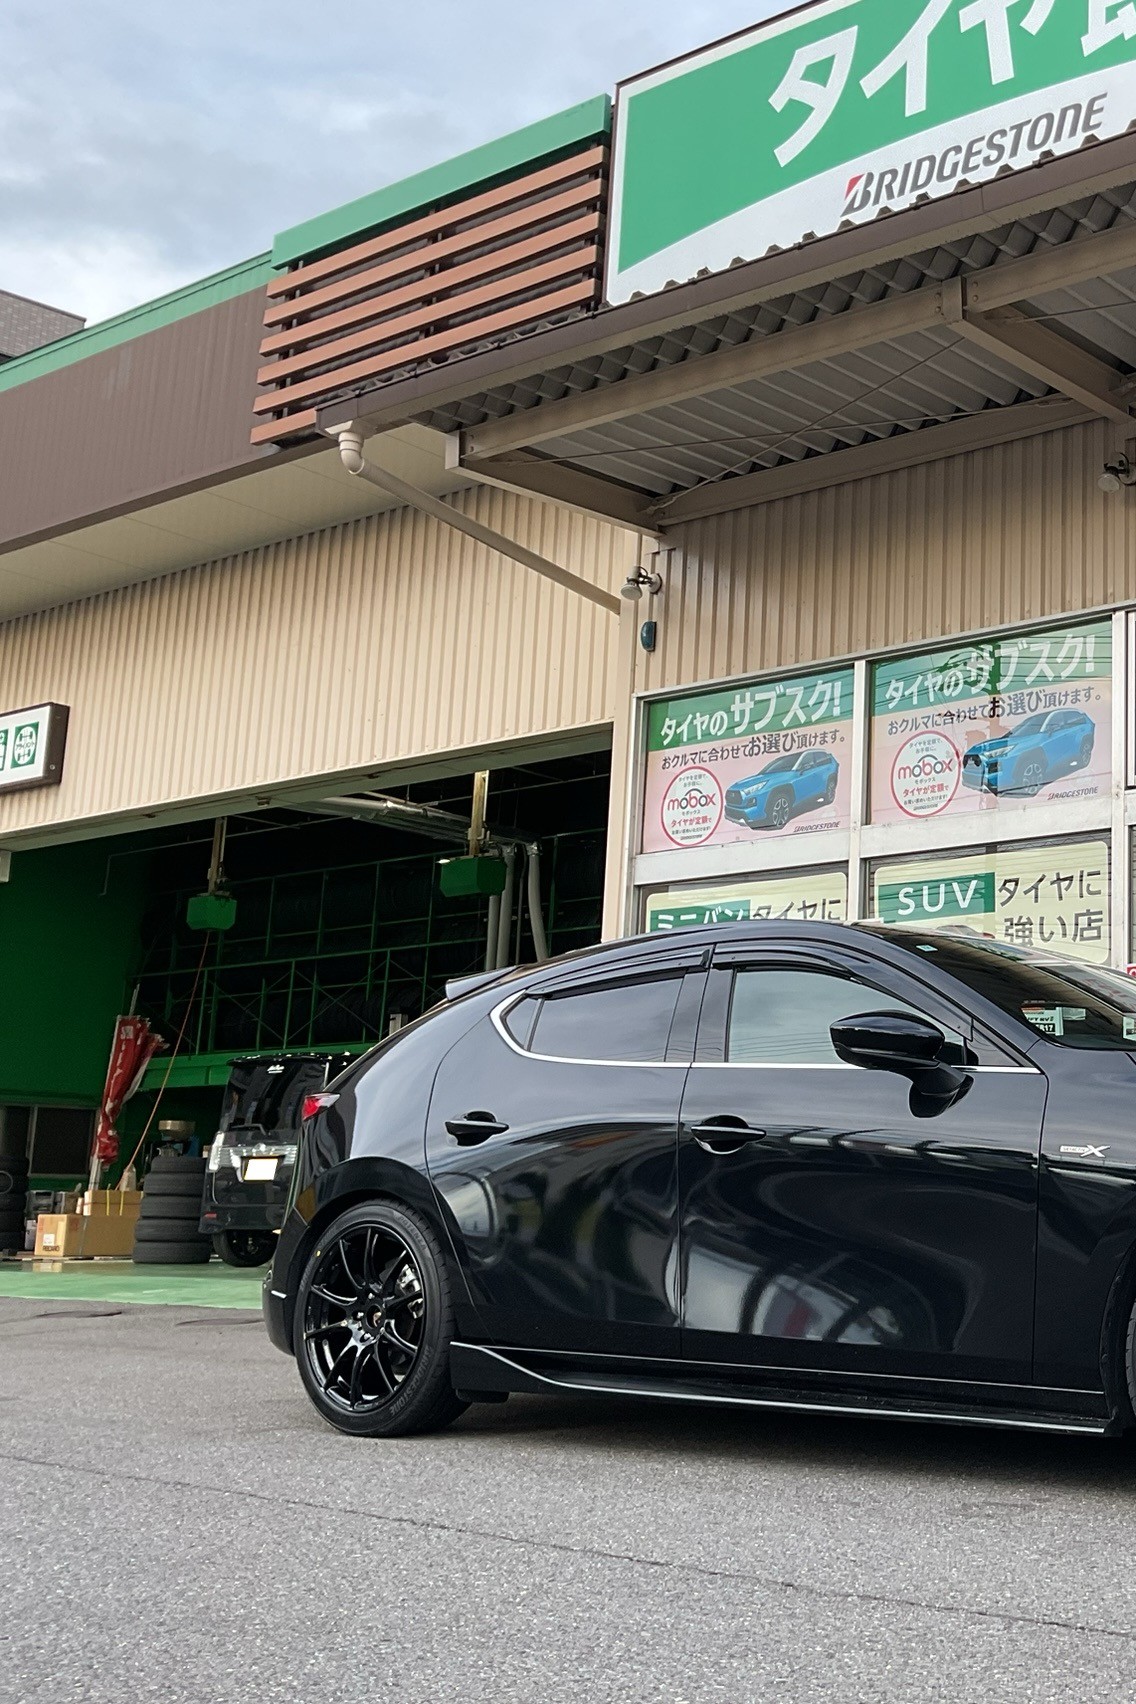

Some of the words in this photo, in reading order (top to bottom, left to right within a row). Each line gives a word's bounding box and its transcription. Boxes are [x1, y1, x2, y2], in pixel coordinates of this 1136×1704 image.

[840, 92, 1107, 217] BRIDGESTONE
[660, 680, 842, 746] タイヤのサブスク!
[898, 758, 953, 779] mobox
[667, 792, 716, 811] mobox
[1047, 786, 1099, 800] BRIDGESTONE
[793, 821, 841, 833] BRIDGESTONE
[897, 879, 980, 915] SUV
[996, 869, 1102, 907] タイヤに
[1003, 908, 1105, 947] 強い店
